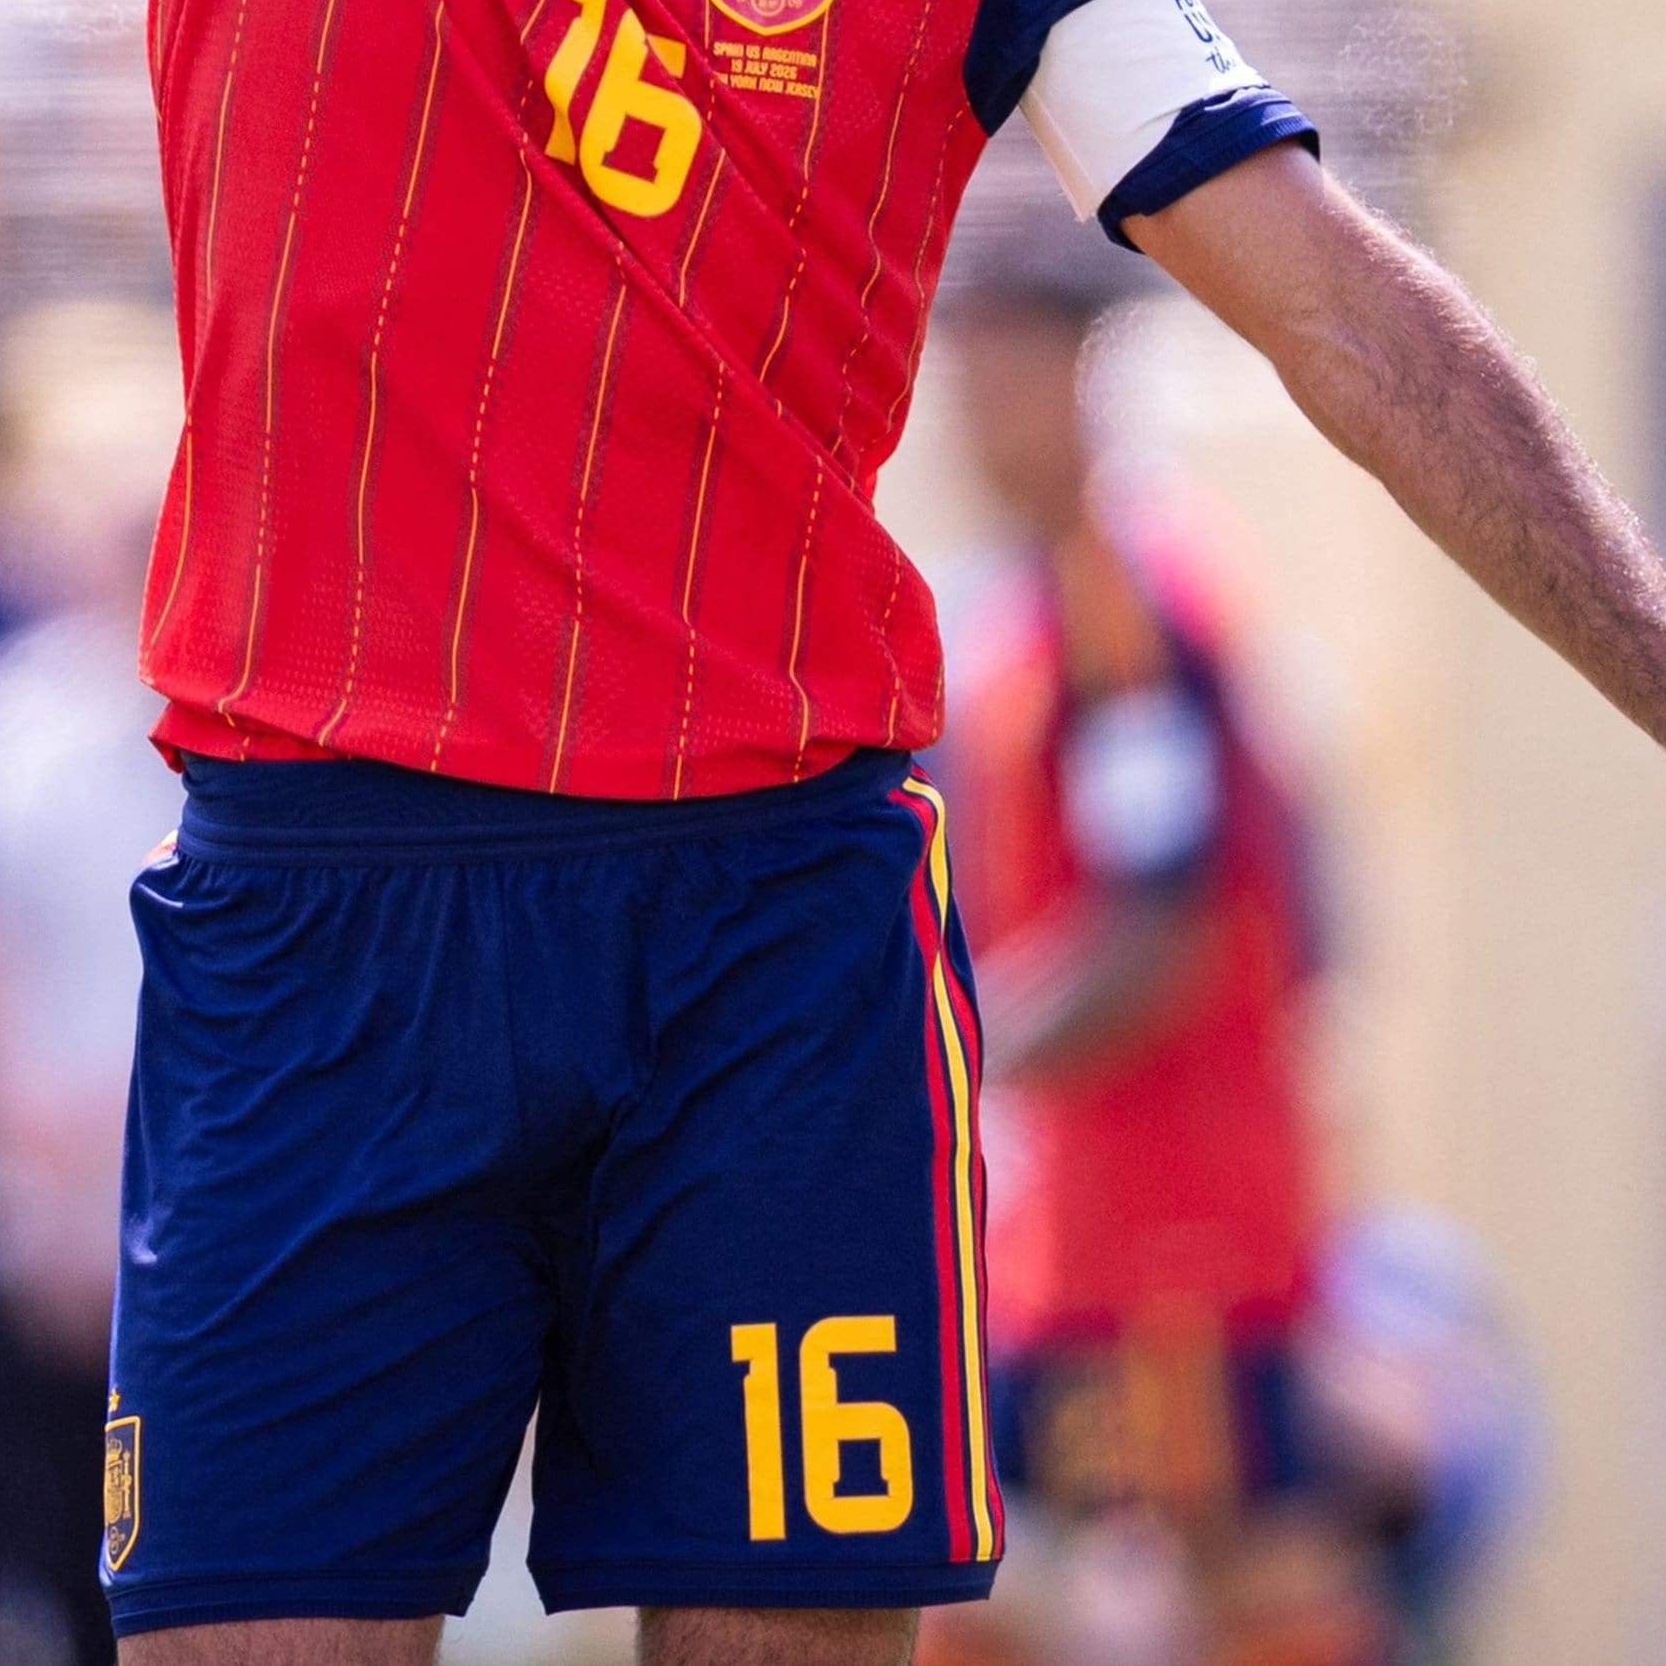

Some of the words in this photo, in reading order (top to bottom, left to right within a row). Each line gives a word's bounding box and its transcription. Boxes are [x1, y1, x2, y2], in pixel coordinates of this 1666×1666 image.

[744, 60, 768, 75] JULY
[770, 63, 797, 80] 2026
[731, 1315, 913, 1541] 16
